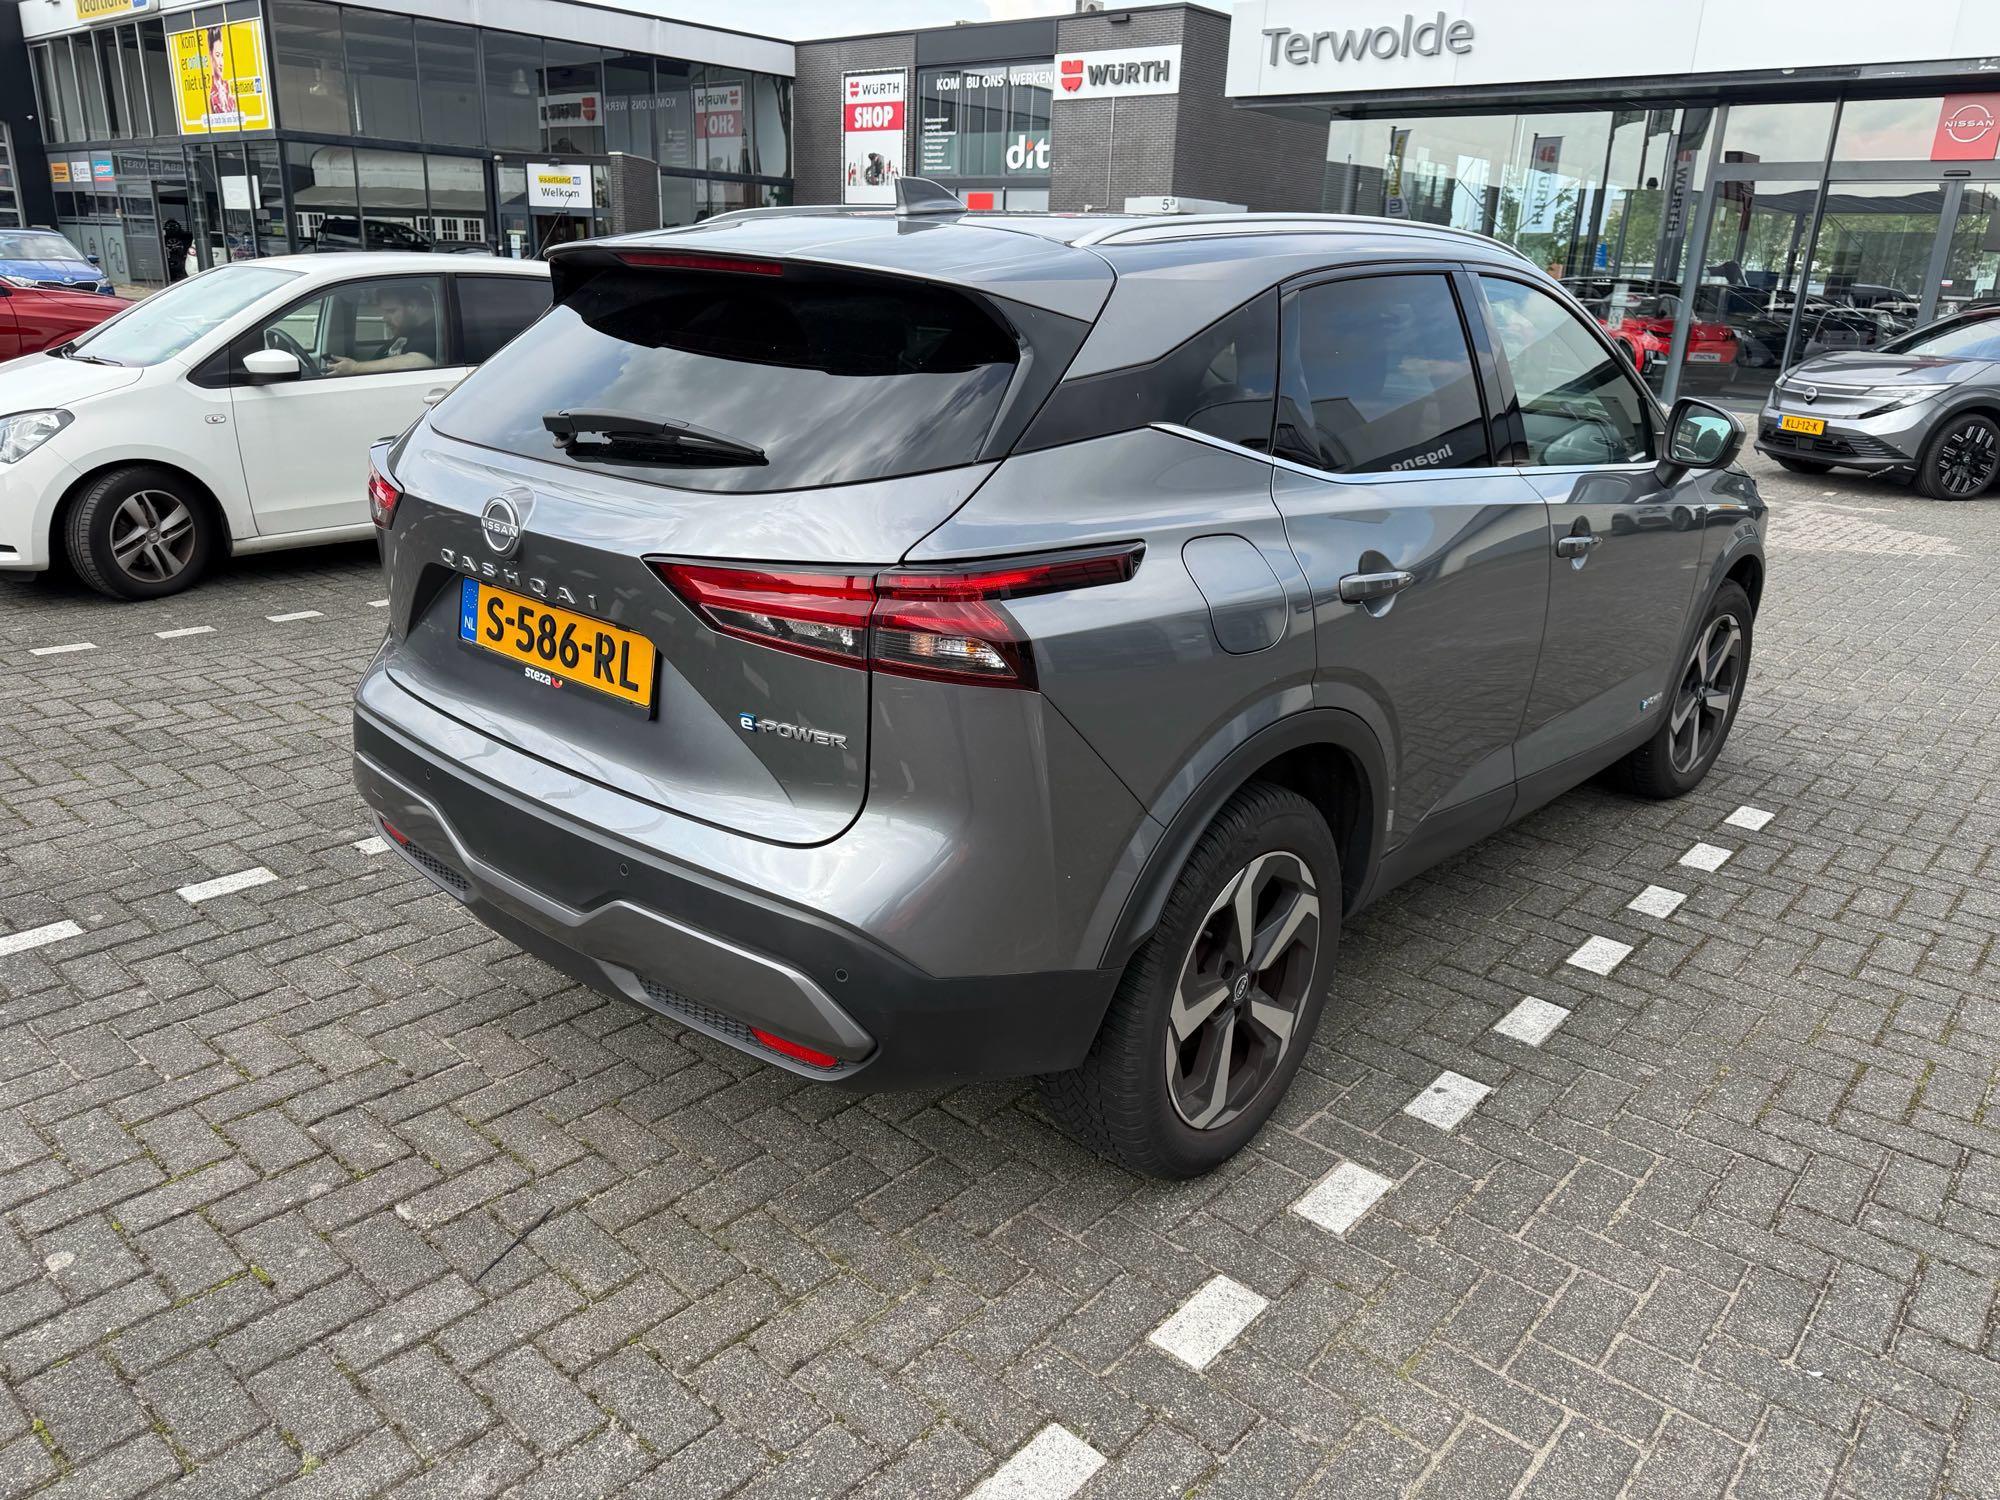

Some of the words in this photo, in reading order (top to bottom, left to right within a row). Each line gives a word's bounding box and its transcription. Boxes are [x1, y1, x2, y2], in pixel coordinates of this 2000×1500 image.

[1262, 11, 1474, 67] Terwolde
[936, 77, 960, 91] KOM
[966, 76, 980, 89] BIJ
[982, 75, 1004, 88] ONS
[1009, 71, 1054, 86] WERKEN
[854, 105, 894, 129] SHOP
[1944, 119, 1995, 128] NISSAN
[1006, 134, 1050, 170] dit
[541, 187, 580, 198] Welkom
[480, 517, 518, 537] NISSAN
[440, 548, 599, 610] QASHQAI
[464, 615, 476, 631] NL
[486, 596, 639, 692] S-586-RL
[524, 666, 551, 686] steza
[740, 714, 848, 750] e-POWER
